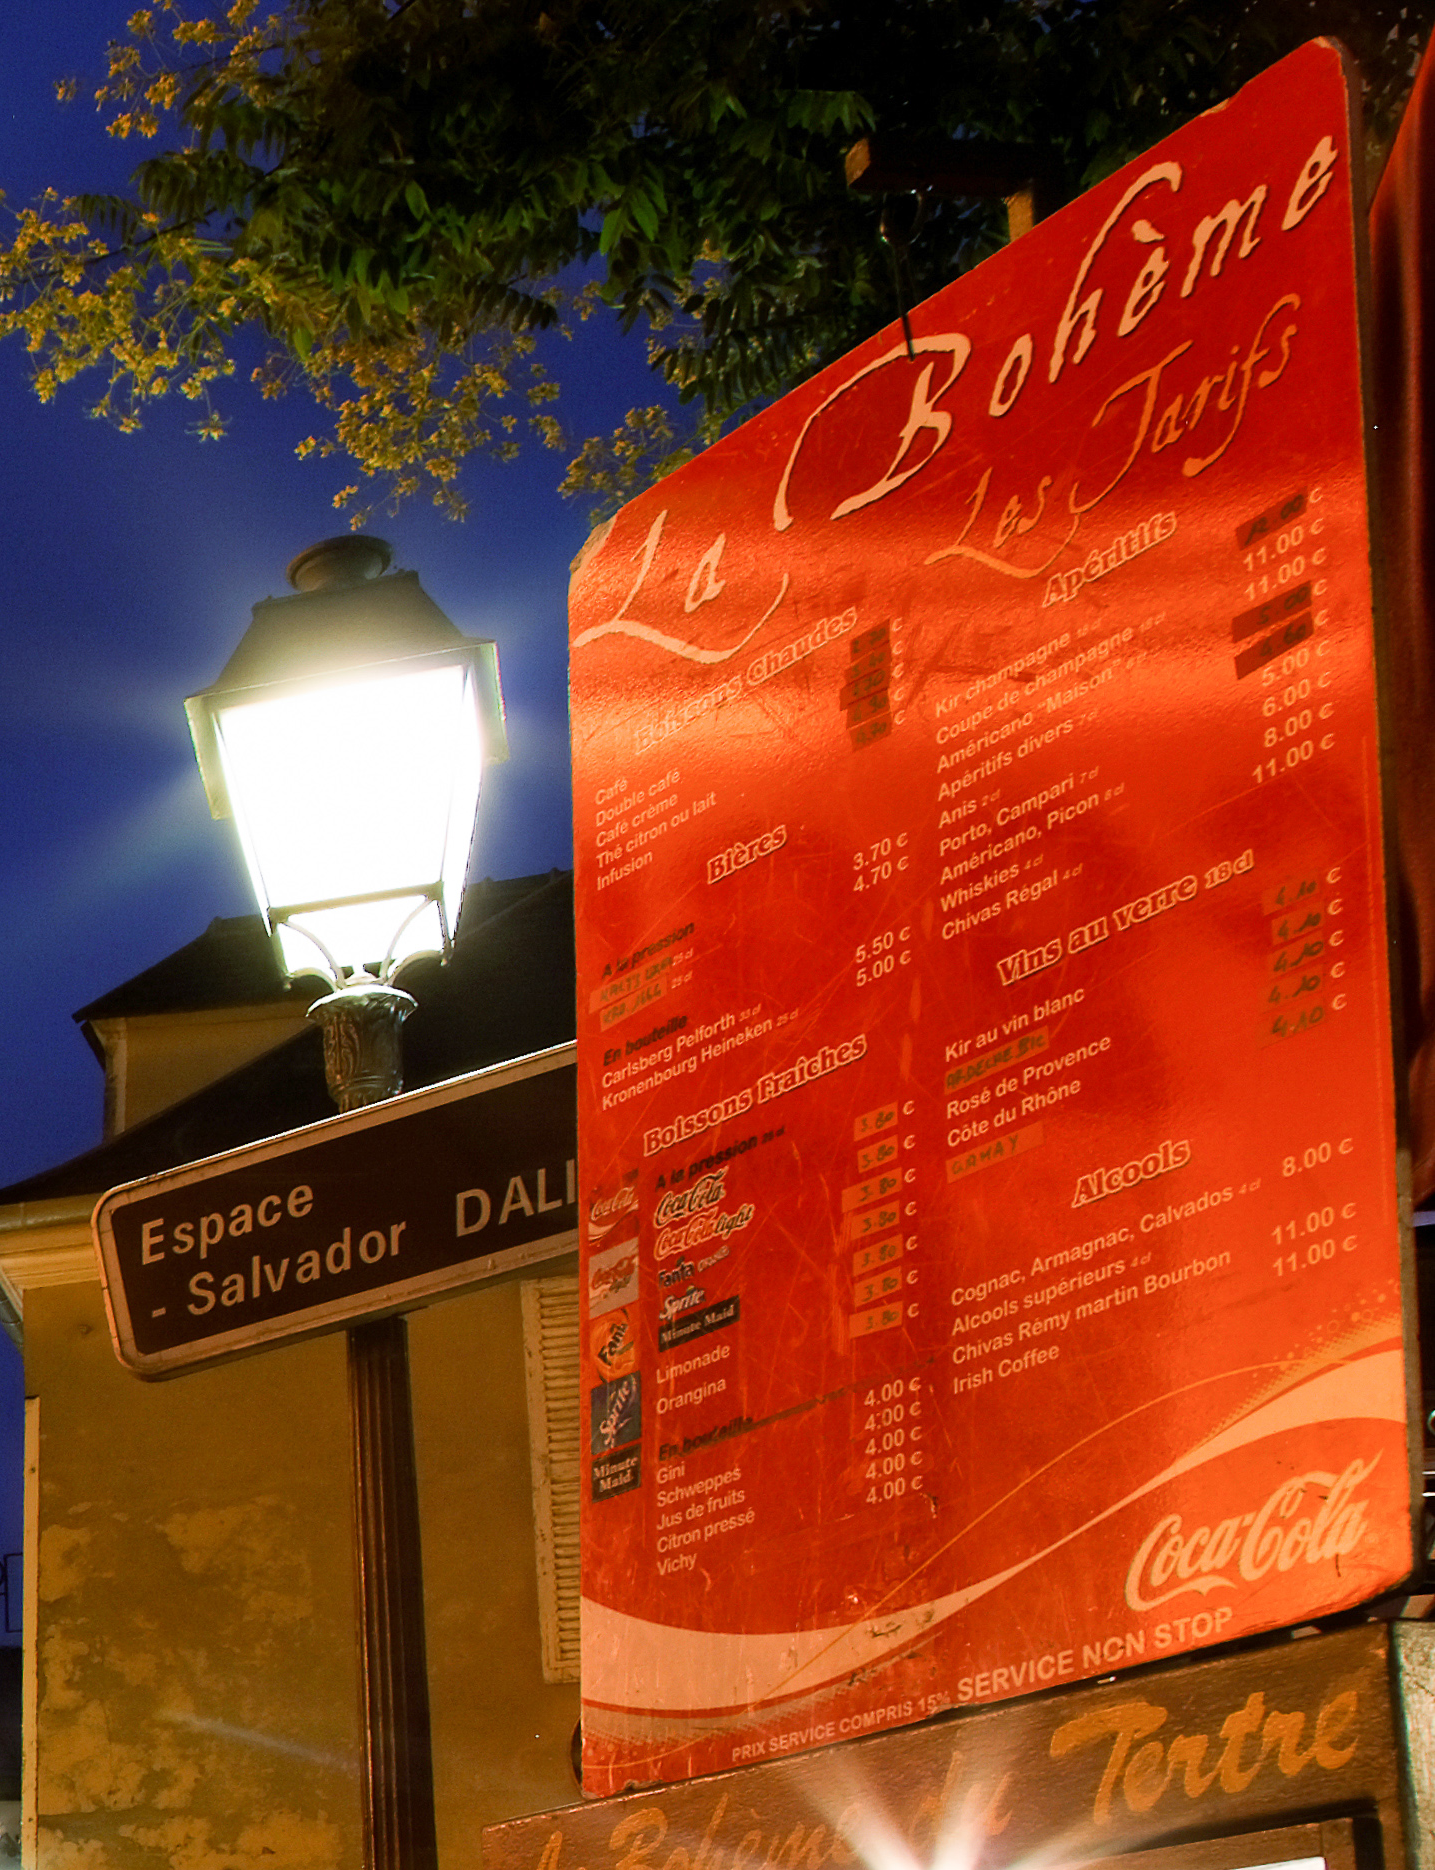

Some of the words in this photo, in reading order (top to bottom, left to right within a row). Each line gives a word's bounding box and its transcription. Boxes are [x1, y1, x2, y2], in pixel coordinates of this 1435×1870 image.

[572, 508, 789, 666] La
[772, 134, 1338, 531] Bohème
[923, 467, 1079, 580] Les
[1070, 293, 1302, 516] Tarifs
[1042, 511, 1177, 608] Apéritifs
[1242, 526, 1304, 573] 11.00
[1244, 555, 1306, 602] 11.00
[935, 687, 962, 718] Kir
[966, 630, 1071, 705] champagne
[935, 699, 994, 746] Coupe
[997, 689, 1020, 713] de
[1024, 625, 1134, 698] champagne
[1261, 648, 1310, 688] 5.00
[1261, 678, 1311, 718] 6.00
[936, 711, 1033, 774] Américano
[1263, 709, 1313, 748] 8.00
[937, 751, 1013, 802] Apéritifs
[1017, 717, 1074, 758] divers
[595, 779, 628, 805] Café
[595, 789, 645, 827] Double
[649, 770, 681, 797] café
[938, 798, 978, 830] Anis
[939, 819, 993, 856] Porto,
[995, 774, 1075, 827] Campari
[596, 821, 629, 848] Café
[632, 794, 678, 826] crème
[597, 846, 623, 869] Thé
[626, 822, 667, 856] citron
[693, 791, 717, 817] lait
[940, 825, 1042, 885] Américano,
[1047, 792, 1099, 830] Picon
[597, 851, 653, 891] Infusion
[707, 824, 787, 885] Bières
[853, 838, 892, 871] 3.70
[940, 860, 1020, 913] Whiskies
[941, 902, 1002, 942] Chivas
[1005, 871, 1059, 914] Régal
[631, 922, 695, 968] pression
[997, 938, 1063, 986] Vins
[1068, 917, 1109, 954] au
[1112, 874, 1197, 932] verre
[602, 1046, 673, 1088] Carlsberg
[677, 1013, 735, 1052] Pelforth
[625, 1015, 688, 1056] bouteille
[945, 1038, 972, 1063] Kir
[976, 1028, 999, 1048] au
[1002, 1014, 1030, 1038] vin
[1033, 987, 1086, 1021] blanc
[602, 1054, 698, 1112] Kronenbourg
[701, 1019, 773, 1061] Heineken
[946, 1087, 992, 1120] Rosé
[995, 1074, 1019, 1095] de
[1022, 1035, 1111, 1087] Provence
[644, 1088, 753, 1157] Boissons
[757, 1033, 867, 1104] Fraîches
[947, 1116, 990, 1149] Côte
[994, 1106, 1018, 1128] du
[1021, 1079, 1082, 1117] Rhône
[1071, 1138, 1193, 1209] Alcools
[140, 1184, 314, 1265] Espace
[716, 1203, 755, 1240] light
[951, 1269, 1027, 1307] Cognac,
[1030, 1227, 1135, 1278] Armagnac,
[1139, 1185, 1235, 1235] Calvados
[186, 1219, 408, 1317] Salvador
[658, 1256, 694, 1287] Fanta
[951, 1301, 1019, 1337] Alcools
[1022, 1256, 1127, 1311] supérieurs
[659, 1285, 705, 1320] Sprite
[661, 1320, 702, 1344] Minute
[704, 1304, 735, 1326] Maid
[951, 1331, 1015, 1367] Chivas
[1017, 1305, 1072, 1341] Rémy
[1076, 1281, 1139, 1320] martin
[1143, 1249, 1232, 1295] Bourbon
[597, 1322, 629, 1367] Fanta
[656, 1344, 731, 1384] Limonade
[952, 1369, 994, 1395] Irish
[998, 1343, 1060, 1379] Coffee
[656, 1378, 727, 1415] Orangina
[864, 1379, 904, 1409] 4.00
[864, 1404, 904, 1434] 4.00
[593, 1456, 639, 1479] Minute
[657, 1461, 685, 1485] Gini
[657, 1466, 742, 1508] Schweppes
[657, 1509, 683, 1531] Jus
[707, 1488, 745, 1512] fruits
[657, 1527, 701, 1553] Citron
[705, 1507, 755, 1541] pressé
[1124, 1449, 1386, 1613] Coca-Cola
[657, 1552, 698, 1577] Vichy
[956, 1649, 1075, 1701] SERVICE
[1152, 1606, 1234, 1650] STOP
[731, 1742, 766, 1762] PRIX
[768, 1720, 837, 1754] SERVICE
[839, 1701, 913, 1733] COMPRIS
[1049, 1691, 1362, 1822] Tertre
